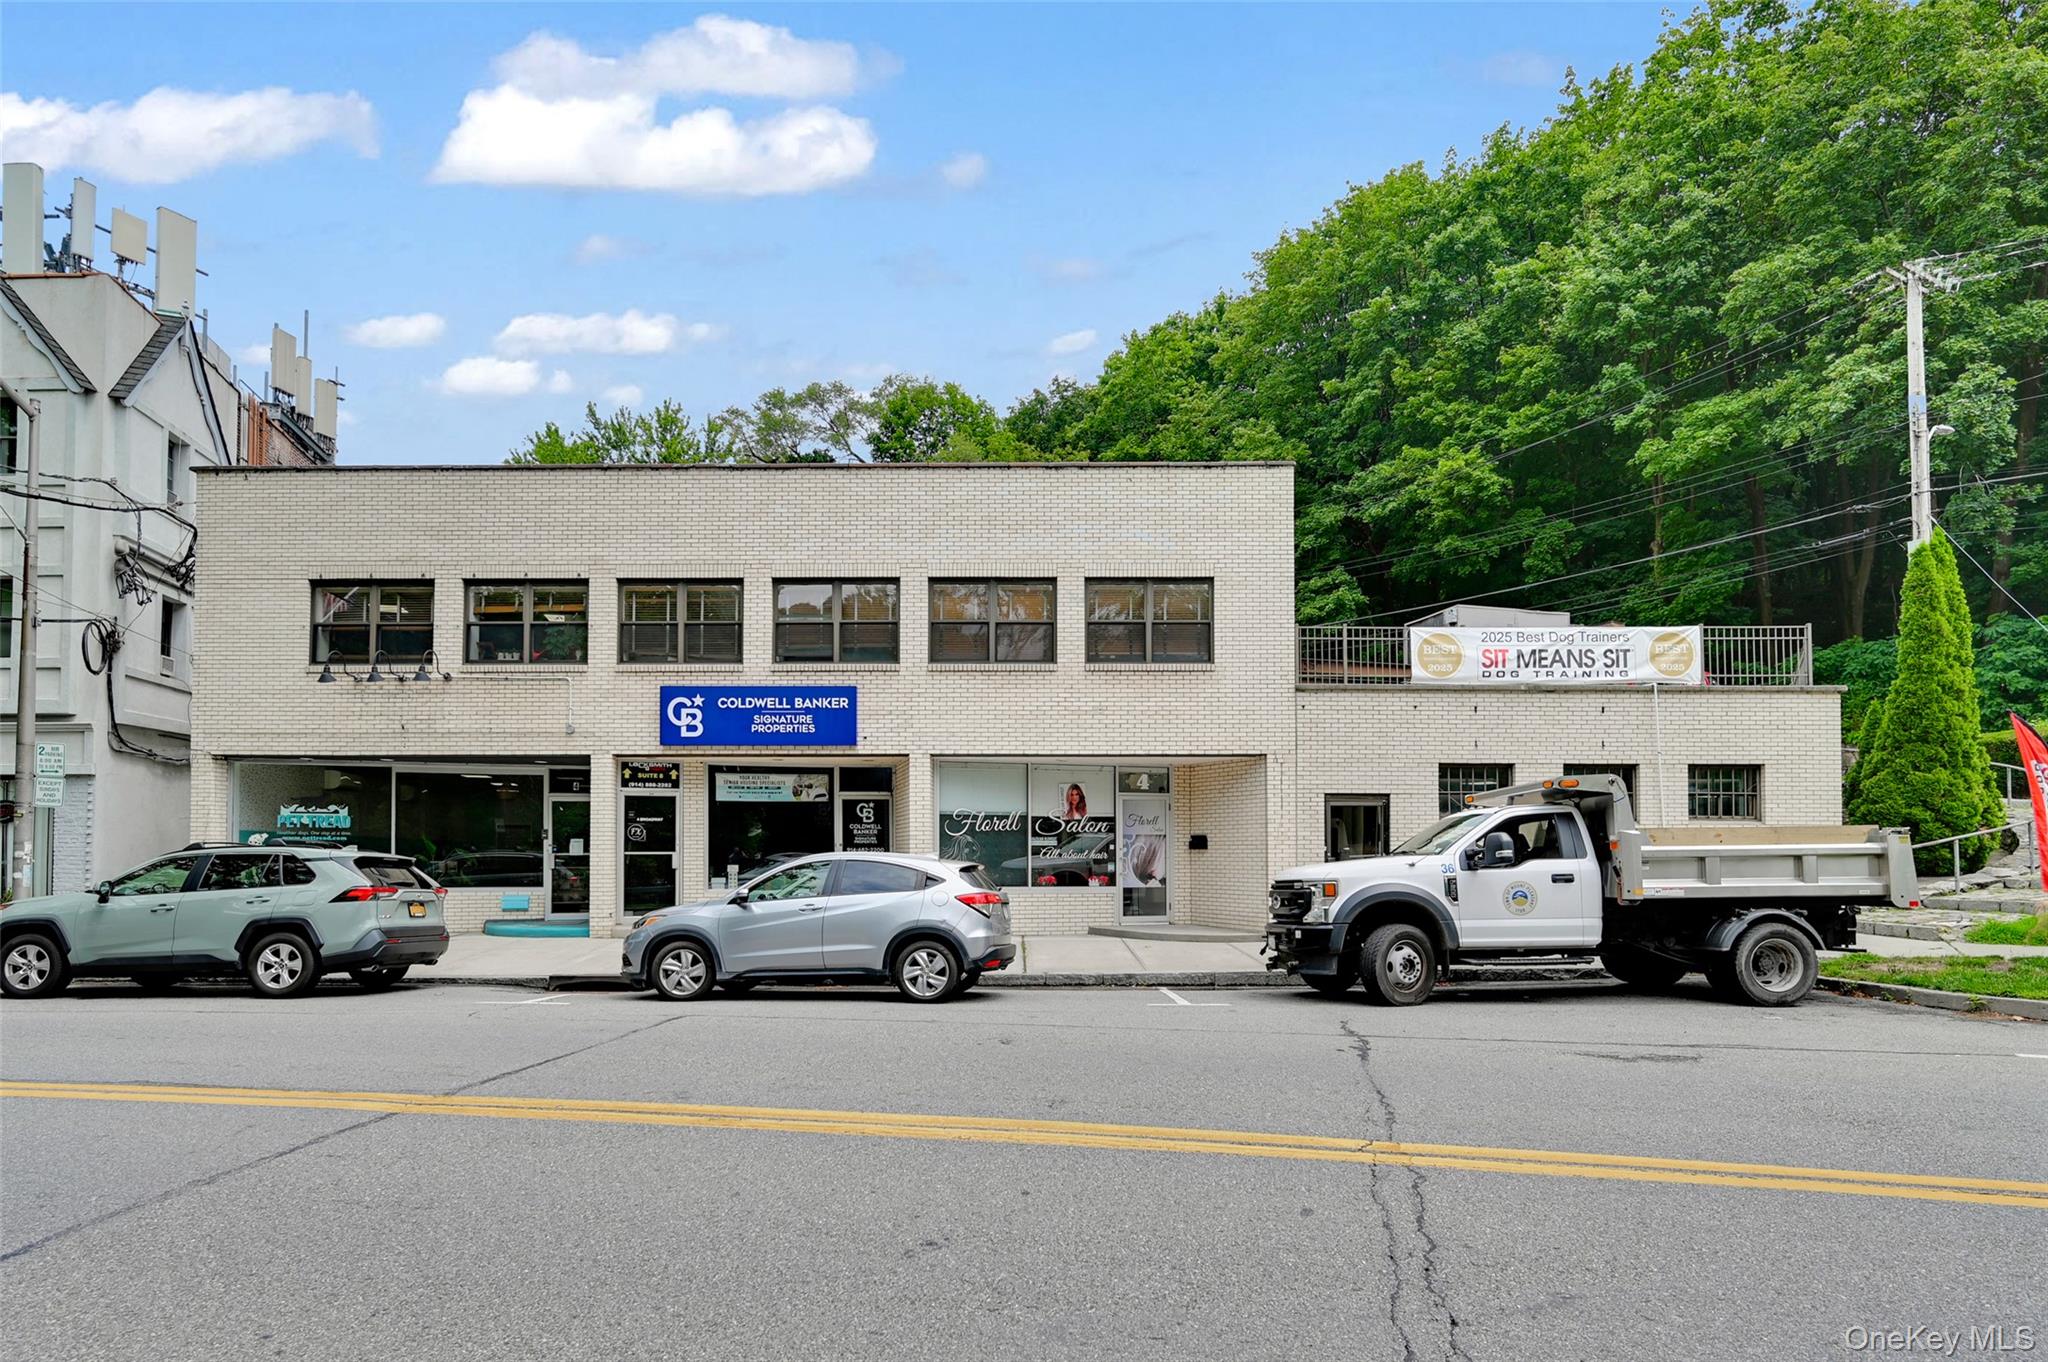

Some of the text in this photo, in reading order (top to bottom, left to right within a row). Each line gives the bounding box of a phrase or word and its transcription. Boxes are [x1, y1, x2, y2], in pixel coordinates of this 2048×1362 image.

[1481, 631, 1630, 645] 2025 Best Dog Trainers
[1423, 644, 1457, 654] BEST
[1655, 643, 1689, 654] BEST
[1481, 648, 1631, 669] SIT MEANS SIT
[1428, 663, 1453, 673] 2025
[1660, 662, 1685, 672] 2025
[1482, 669, 1629, 678] DOG TRAINING
[717, 697, 849, 709] COLDWELL BANKER
[753, 714, 813, 724] SIGNATURE
[751, 724, 816, 733] PROPERTIES
[39, 746, 46, 756] 2
[1136, 773, 1150, 790] 4
[277, 814, 351, 829] PET TREAD
[944, 807, 1024, 836] Florell
[1035, 808, 1112, 836] Salon
[1125, 813, 1160, 828] Florell
[1039, 847, 1109, 860] All about hair
[1440, 863, 1455, 874] 36
